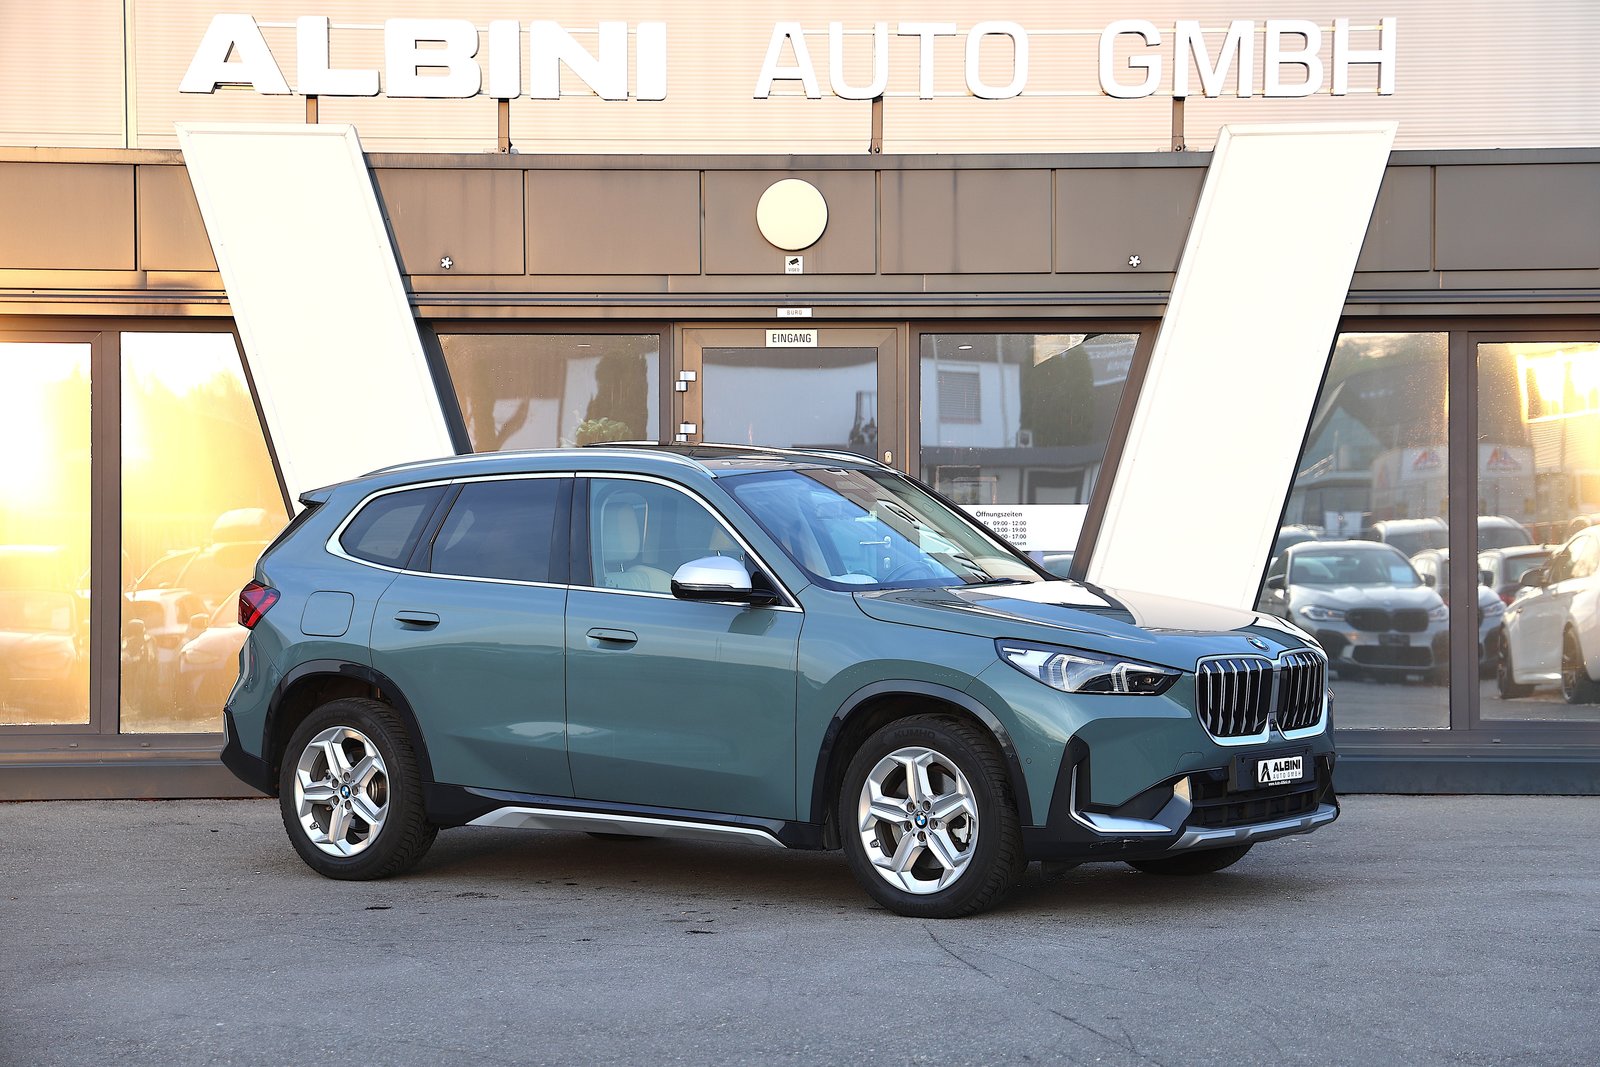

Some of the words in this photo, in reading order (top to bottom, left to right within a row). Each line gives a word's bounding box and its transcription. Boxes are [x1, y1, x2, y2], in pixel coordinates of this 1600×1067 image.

[179, 14, 667, 101] ALBINI
[753, 20, 1030, 101] AUTO
[1097, 17, 1398, 99] GMBH
[772, 333, 812, 343] EINGANG
[976, 510, 1023, 518] Öffnungszeiten
[894, 728, 936, 739] KUMHO
[1273, 759, 1301, 772] ALBINI
